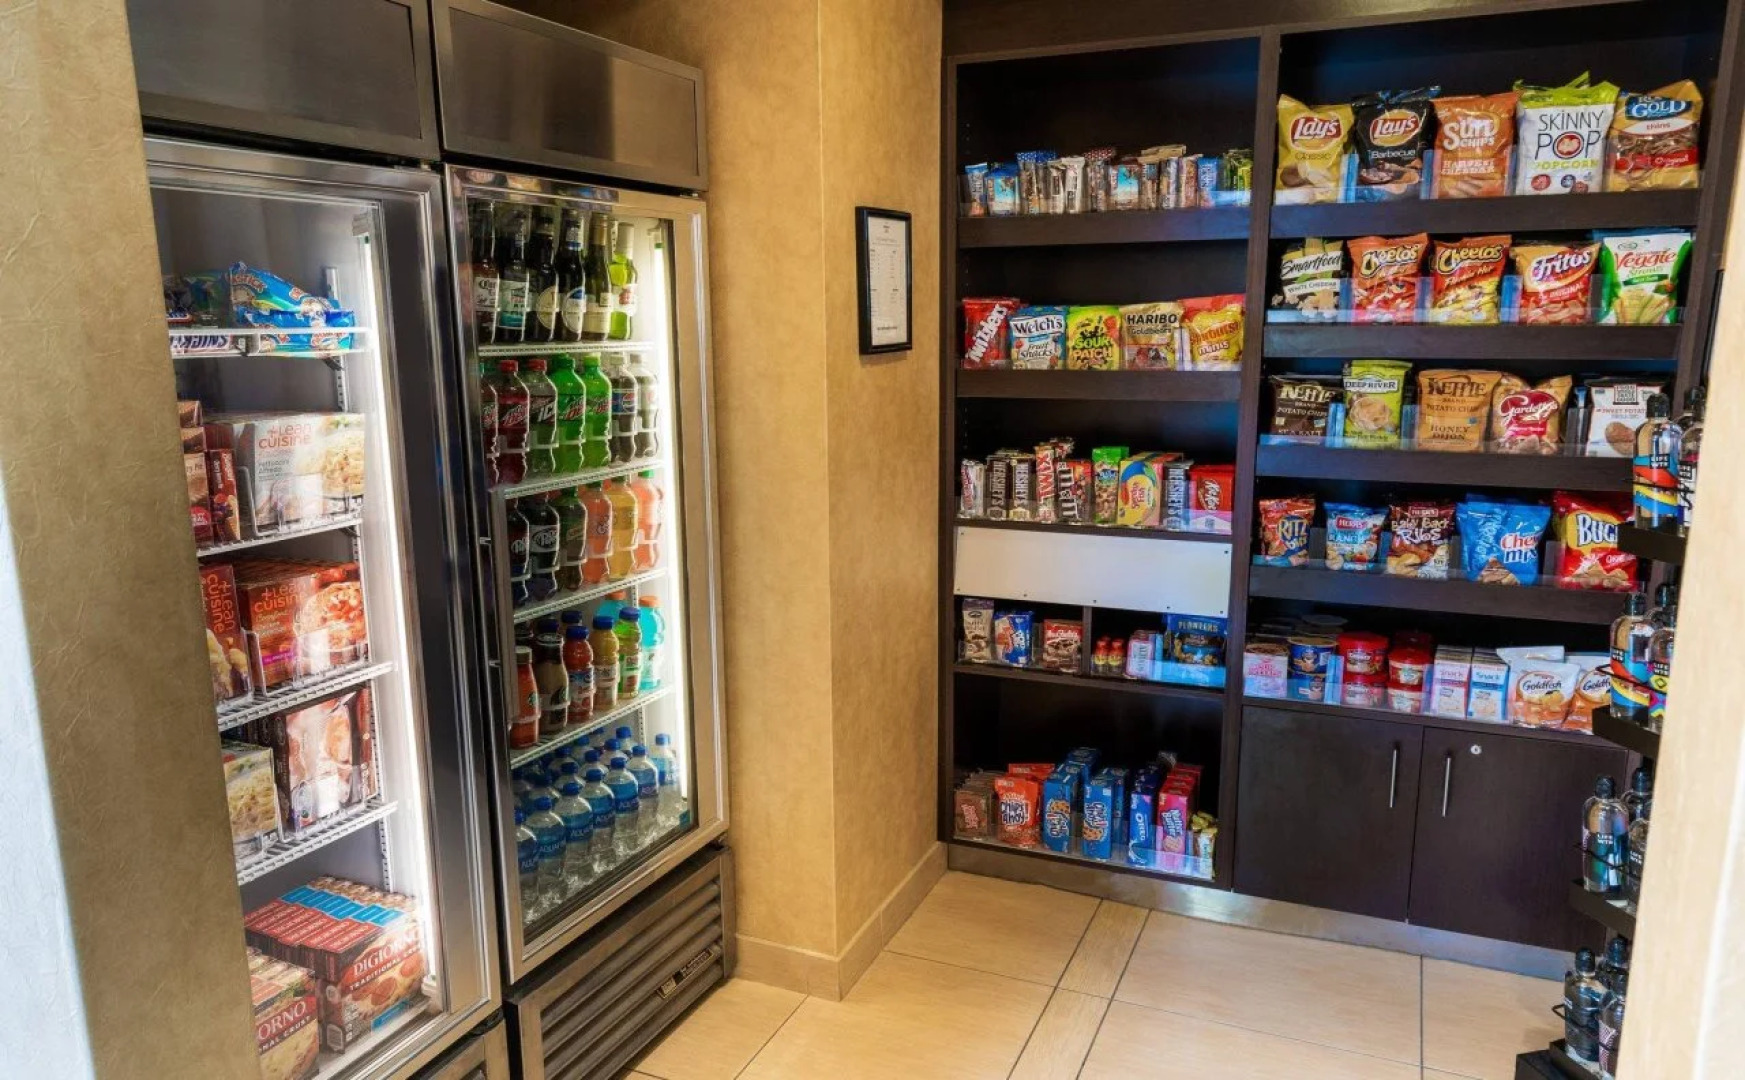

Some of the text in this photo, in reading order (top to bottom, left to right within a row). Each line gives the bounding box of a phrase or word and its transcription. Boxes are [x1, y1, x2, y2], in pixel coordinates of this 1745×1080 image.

[1631, 99, 1686, 117] GOLD
[1293, 117, 1341, 140] Lay's
[1373, 116, 1418, 139] Lay's
[1539, 111, 1605, 132] SKINNY
[1646, 121, 1672, 132] thins
[1442, 116, 1495, 151] Sun
[1460, 137, 1495, 149] CHIPS
[1371, 149, 1416, 161] Barbecue
[1534, 131, 1603, 161] POP
[1281, 250, 1342, 278] Smartfood
[1360, 244, 1421, 278] Cheetos
[1437, 244, 1504, 275] Cheetos
[1530, 248, 1592, 281] Fritos
[1614, 250, 1677, 271] Veggie
[1286, 281, 1338, 295] WHITE CHEDDAR
[1013, 315, 1063, 335] Welch's
[1126, 313, 1178, 325] HARIBO
[1345, 380, 1397, 390] DEEP RIVER
[1432, 424, 1471, 435] HONEY
[1168, 468, 1184, 516] HERSHEY'S
[1278, 518, 1308, 541] RITZ
[1178, 621, 1219, 633] PLANTERS
[1522, 678, 1562, 691] Goldfish
[1135, 812, 1146, 841] OREO
[1161, 812, 1177, 837] Butter
